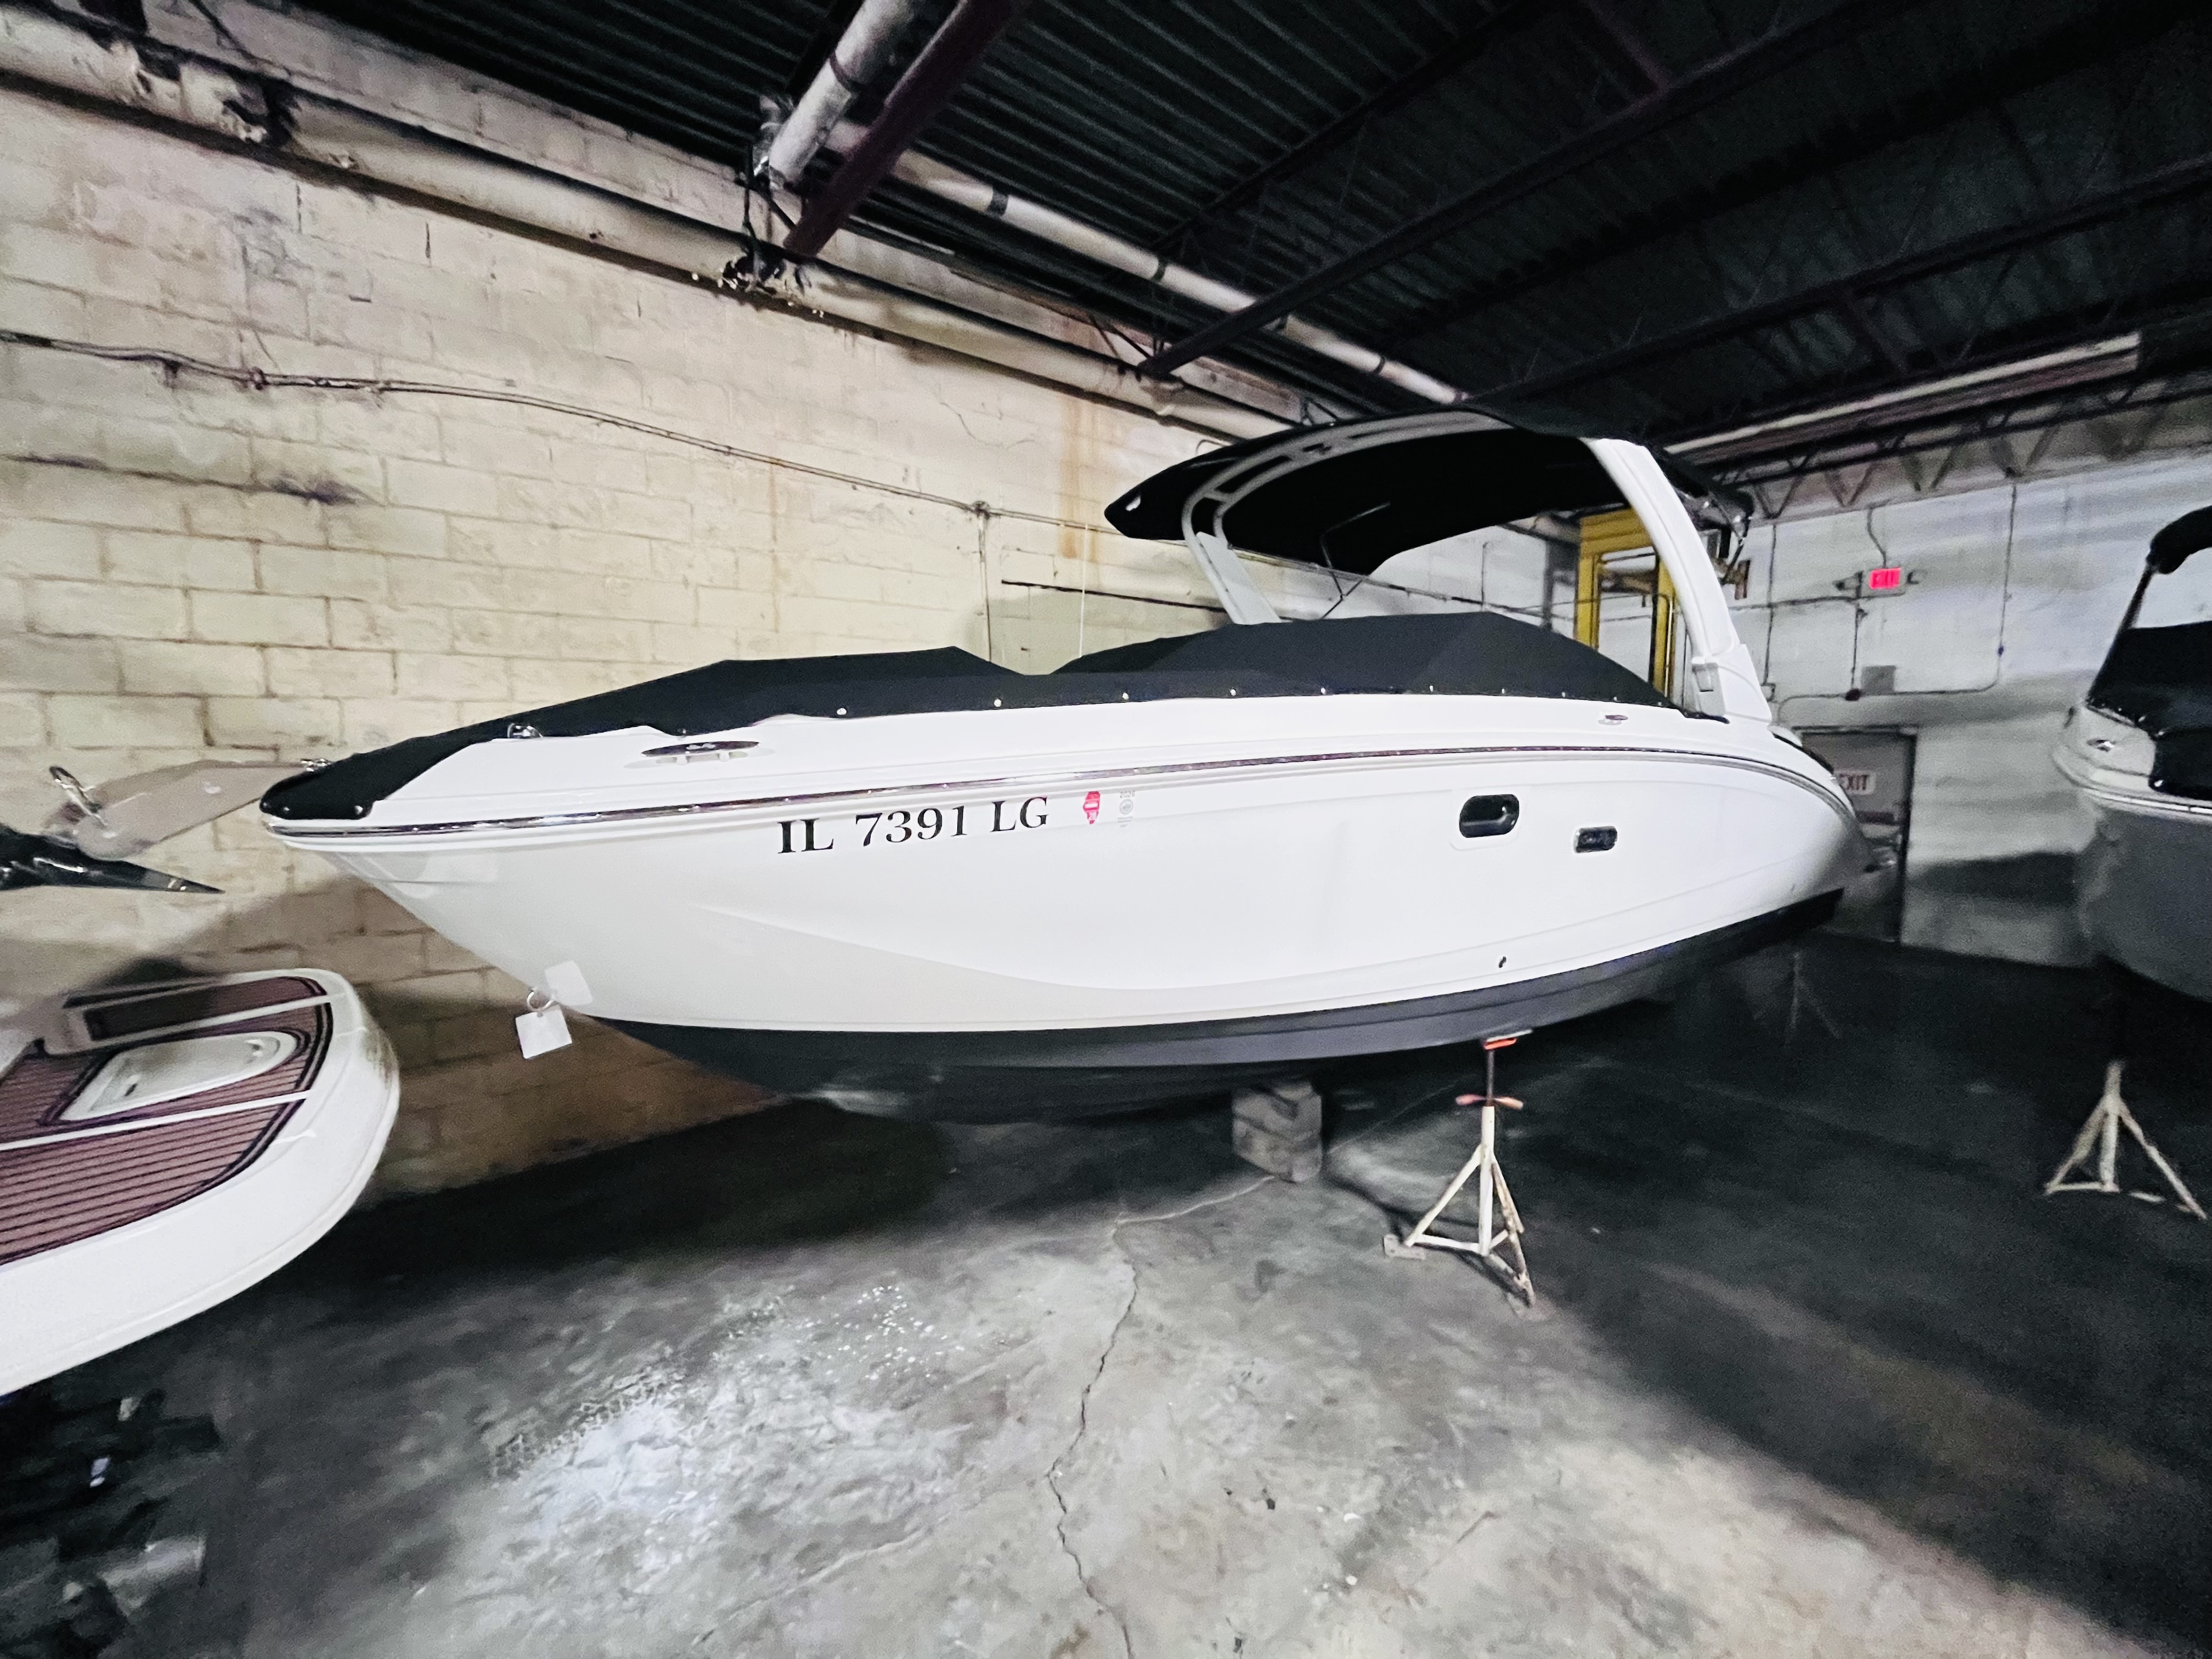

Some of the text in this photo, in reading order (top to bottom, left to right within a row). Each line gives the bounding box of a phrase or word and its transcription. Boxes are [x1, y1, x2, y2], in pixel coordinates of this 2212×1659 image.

[777, 796, 1048, 854] IL 7391 LG
